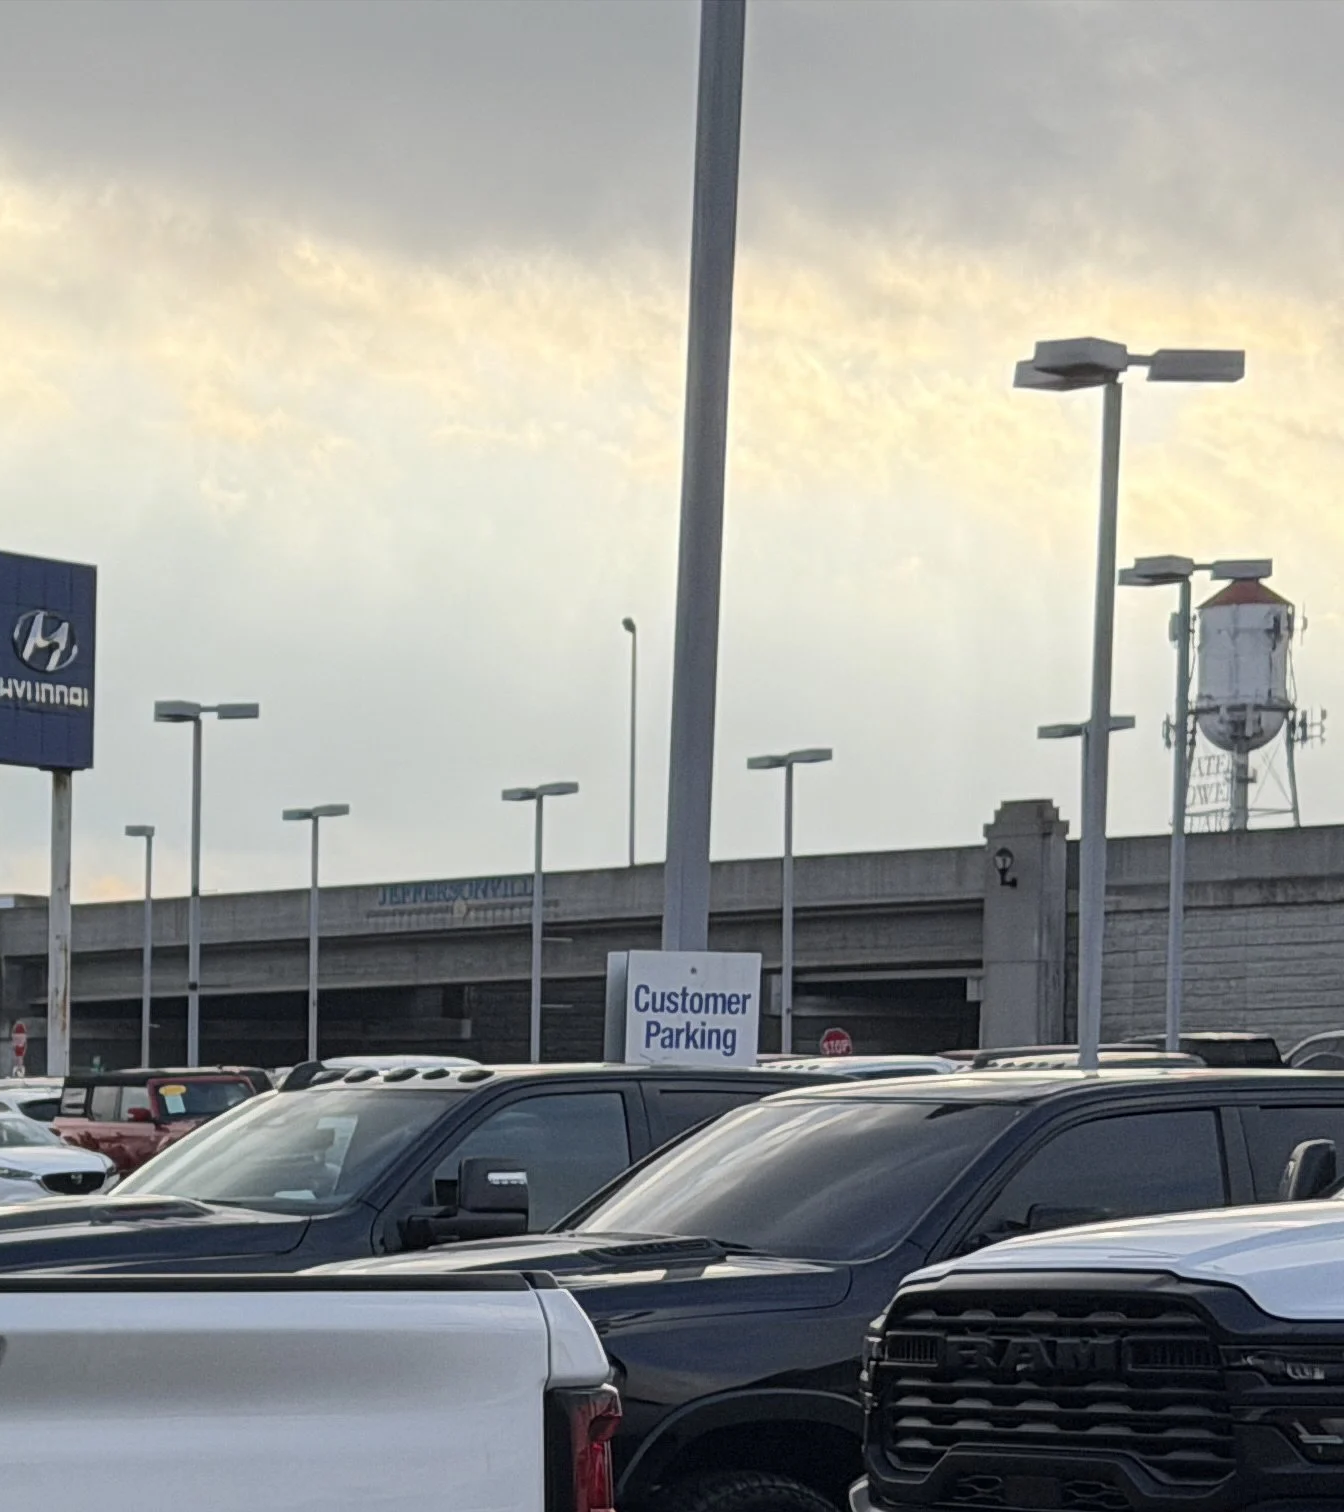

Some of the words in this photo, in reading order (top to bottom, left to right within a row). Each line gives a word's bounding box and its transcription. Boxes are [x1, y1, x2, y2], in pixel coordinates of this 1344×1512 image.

[378, 875, 545, 905] JEFFERSONVILL
[634, 984, 752, 1015] Customer
[645, 1020, 737, 1057] Parking
[822, 1039, 849, 1055] STOP
[947, 1333, 1120, 1373] RAM
